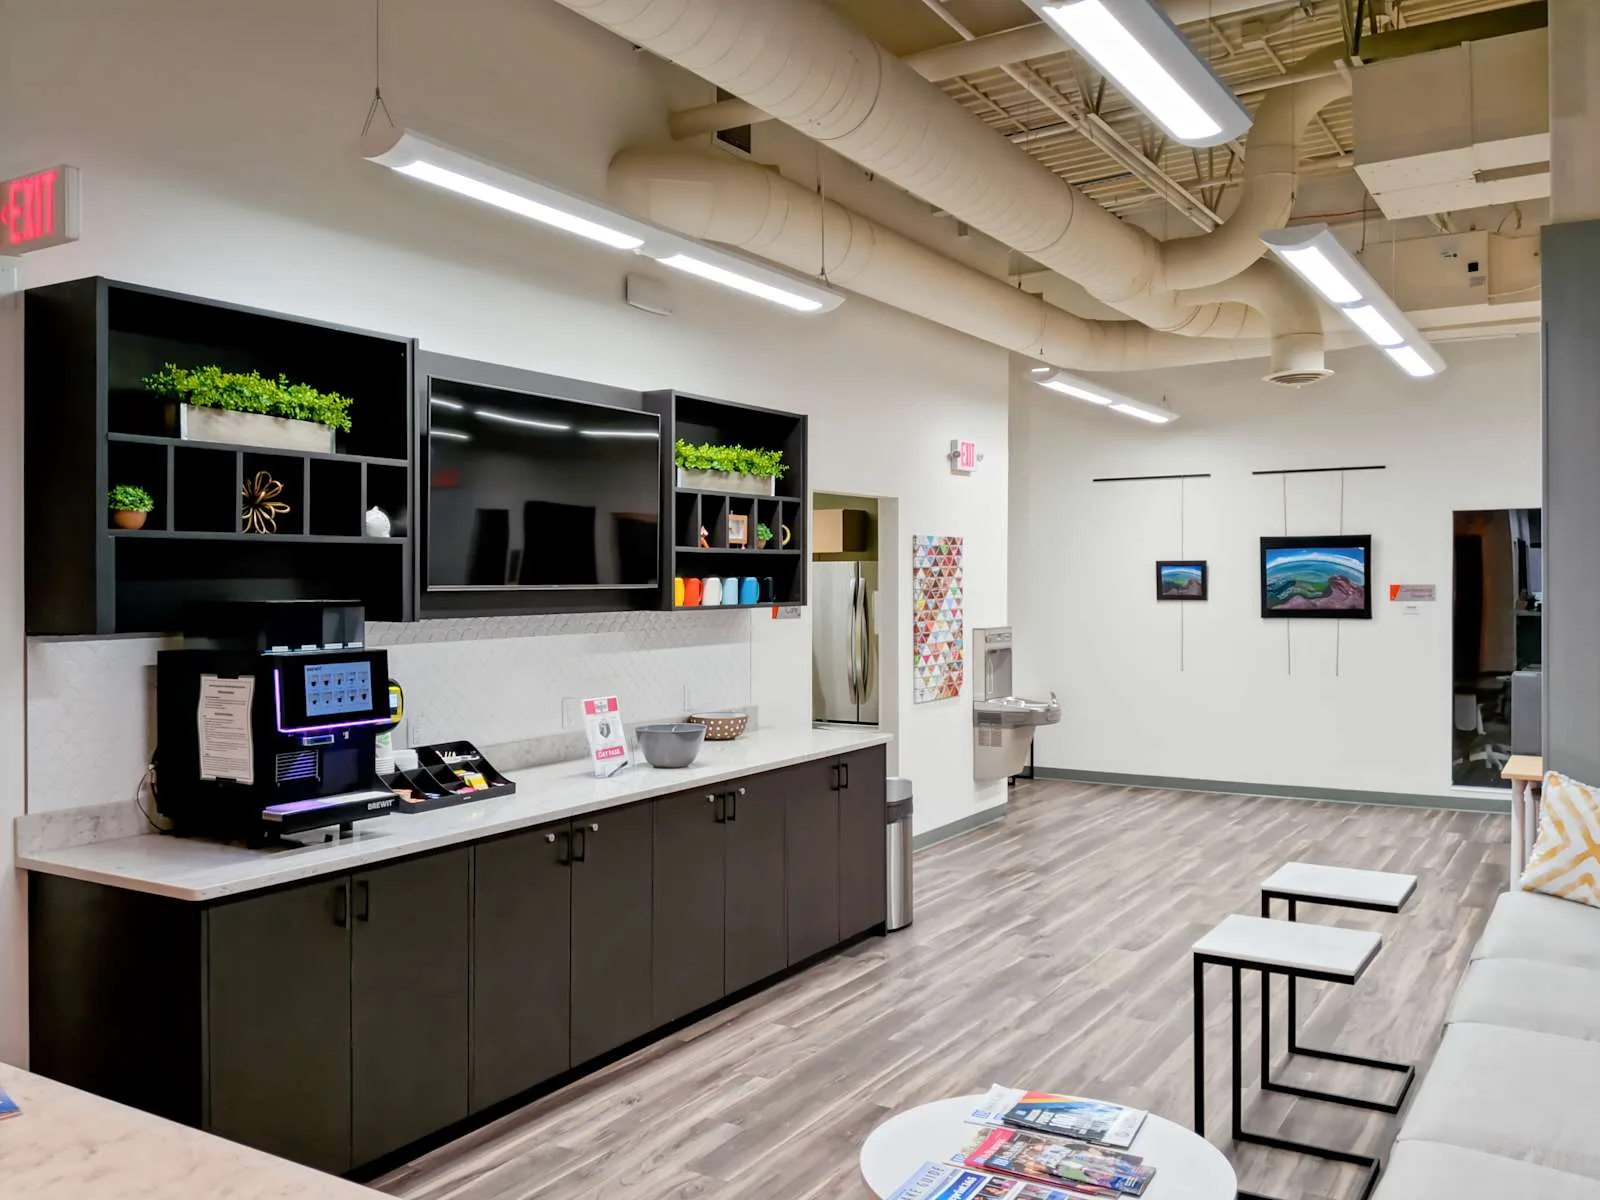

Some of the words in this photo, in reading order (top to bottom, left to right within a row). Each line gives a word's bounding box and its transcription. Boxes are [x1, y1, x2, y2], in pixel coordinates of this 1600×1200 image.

[9, 170, 57, 245] EXIT
[961, 442, 975, 467] EXIT
[367, 799, 394, 810] BREWIT
